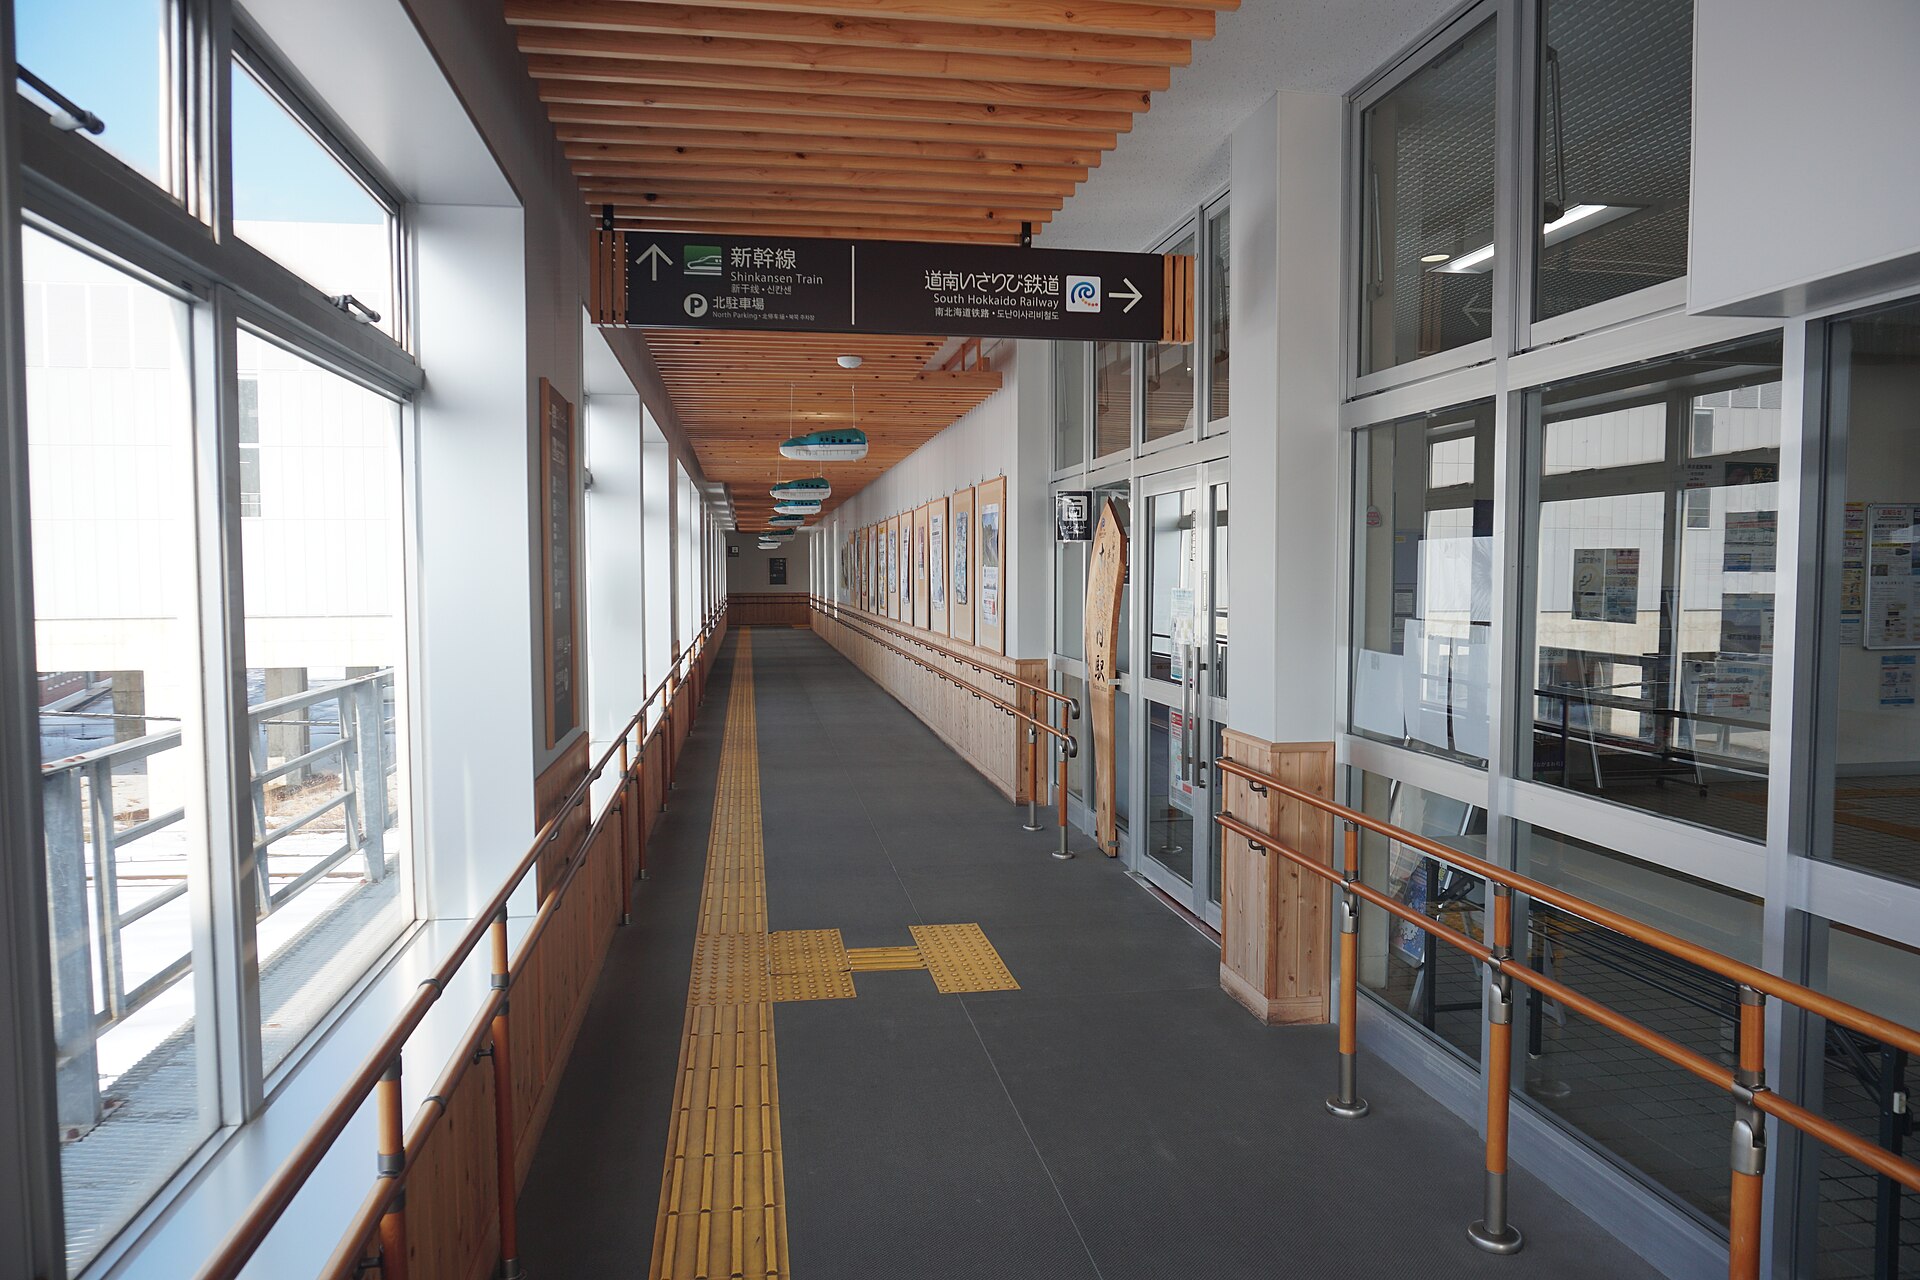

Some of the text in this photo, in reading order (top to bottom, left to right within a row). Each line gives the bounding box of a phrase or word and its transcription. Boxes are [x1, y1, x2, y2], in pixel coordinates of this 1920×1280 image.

[730, 246, 797, 270] 新幹線
[730, 271, 823, 285] Shinkansen Train
[924, 269, 1060, 296] 道南いさりび鉄道
[712, 296, 765, 311] 北駐車場
[933, 292, 1059, 310] South Hokkaido Railway
[712, 311, 732, 319] North
[732, 311, 758, 321] Parking
